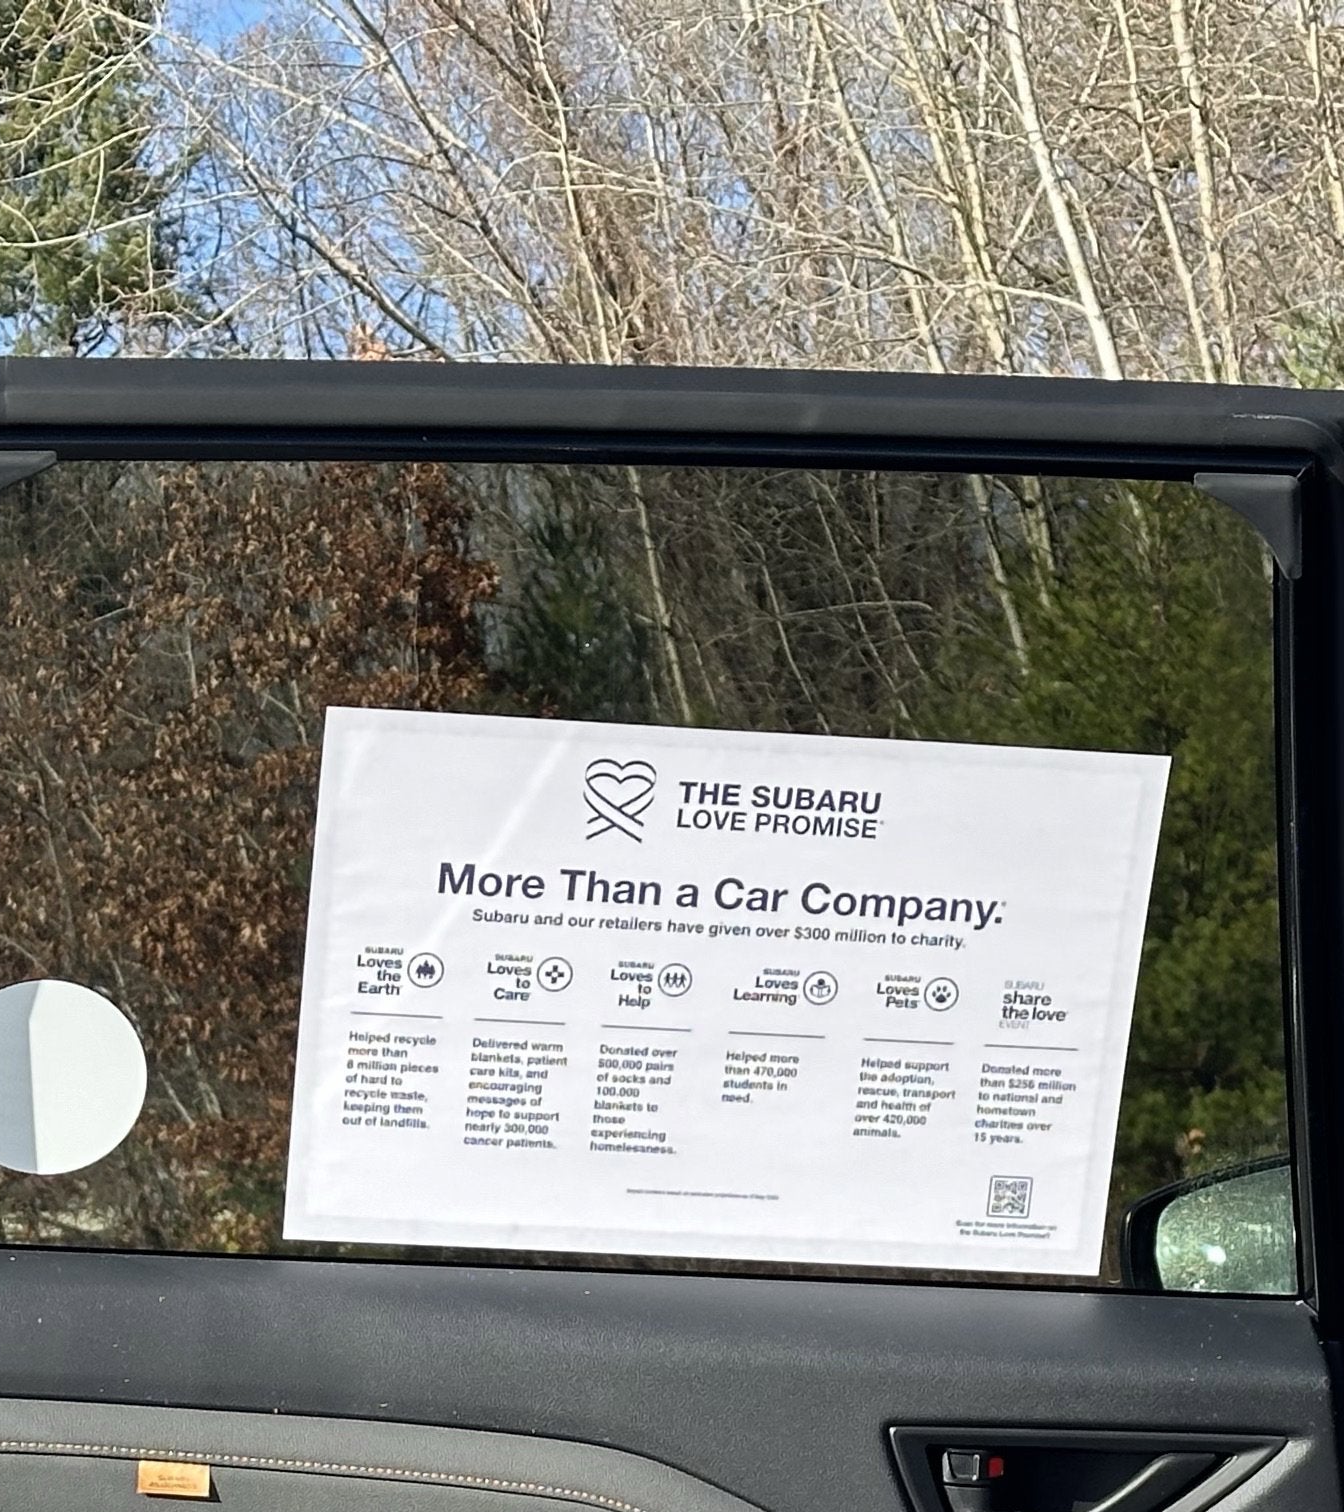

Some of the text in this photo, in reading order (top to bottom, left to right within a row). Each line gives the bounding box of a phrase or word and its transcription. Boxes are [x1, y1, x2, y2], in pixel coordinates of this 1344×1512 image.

[678, 780, 882, 815] THE SUBARU
[676, 807, 748, 832] LOVE
[437, 861, 546, 900] More
[559, 868, 662, 907] Than
[675, 883, 700, 909] a
[714, 877, 790, 913] Car
[471, 907, 967, 952] Subaru and our retailers have given over $300 million to charity.
[357, 954, 402, 969] Loves
[487, 961, 532, 976] Loves
[377, 969, 401, 982] the
[611, 968, 653, 982] Loves
[358, 980, 400, 995] Earth
[516, 976, 530, 989] to
[638, 983, 652, 994] to
[755, 975, 798, 990] Loves
[877, 981, 919, 996] Loves
[494, 987, 530, 1001] Care
[733, 987, 797, 1005] Learning
[1003, 989, 1052, 1006] share
[618, 993, 650, 1010] Help
[886, 995, 918, 1009] Pets
[1002, 1005, 1065, 1021] the love
[349, 1030, 391, 1044] Helped
[472, 1036, 563, 1052] Delivered warm
[348, 1046, 408, 1058] more than
[600, 1043, 678, 1058] Donated over
[726, 1049, 800, 1064] Helped more
[357, 1060, 397, 1071] million
[400, 1061, 439, 1074] pieces
[527, 1054, 568, 1067] patient
[645, 1060, 674, 1073] pairs
[861, 1056, 950, 1073] Helped support
[469, 1067, 495, 1076] care
[525, 1068, 548, 1079] and
[724, 1063, 750, 1075] than
[981, 1062, 1062, 1077] Donated more
[345, 1072, 403, 1086] of hard to
[596, 1071, 672, 1085] of socks and
[859, 1071, 878, 1082] the
[468, 1081, 542, 1095] encouraging
[722, 1078, 788, 1091] students in
[980, 1076, 1005, 1088] than
[1038, 1079, 1077, 1092] million
[903, 1087, 956, 1100] transport
[978, 1090, 1063, 1104] to national and
[343, 1100, 423, 1115] keeping them
[467, 1095, 542, 1108] messages of
[594, 1098, 658, 1113] blankets to
[856, 1099, 932, 1112] and health of
[466, 1106, 559, 1122] hope to support
[976, 1103, 1036, 1117] hometown
[342, 1115, 362, 1125] out
[365, 1115, 377, 1126] of
[593, 1113, 626, 1124] those
[854, 1113, 881, 1123] over
[974, 1118, 1053, 1131] charities over
[465, 1121, 501, 1134] nearly
[463, 1135, 504, 1146] cancer
[591, 1127, 666, 1143] experiencing
[974, 1131, 987, 1142] 15
